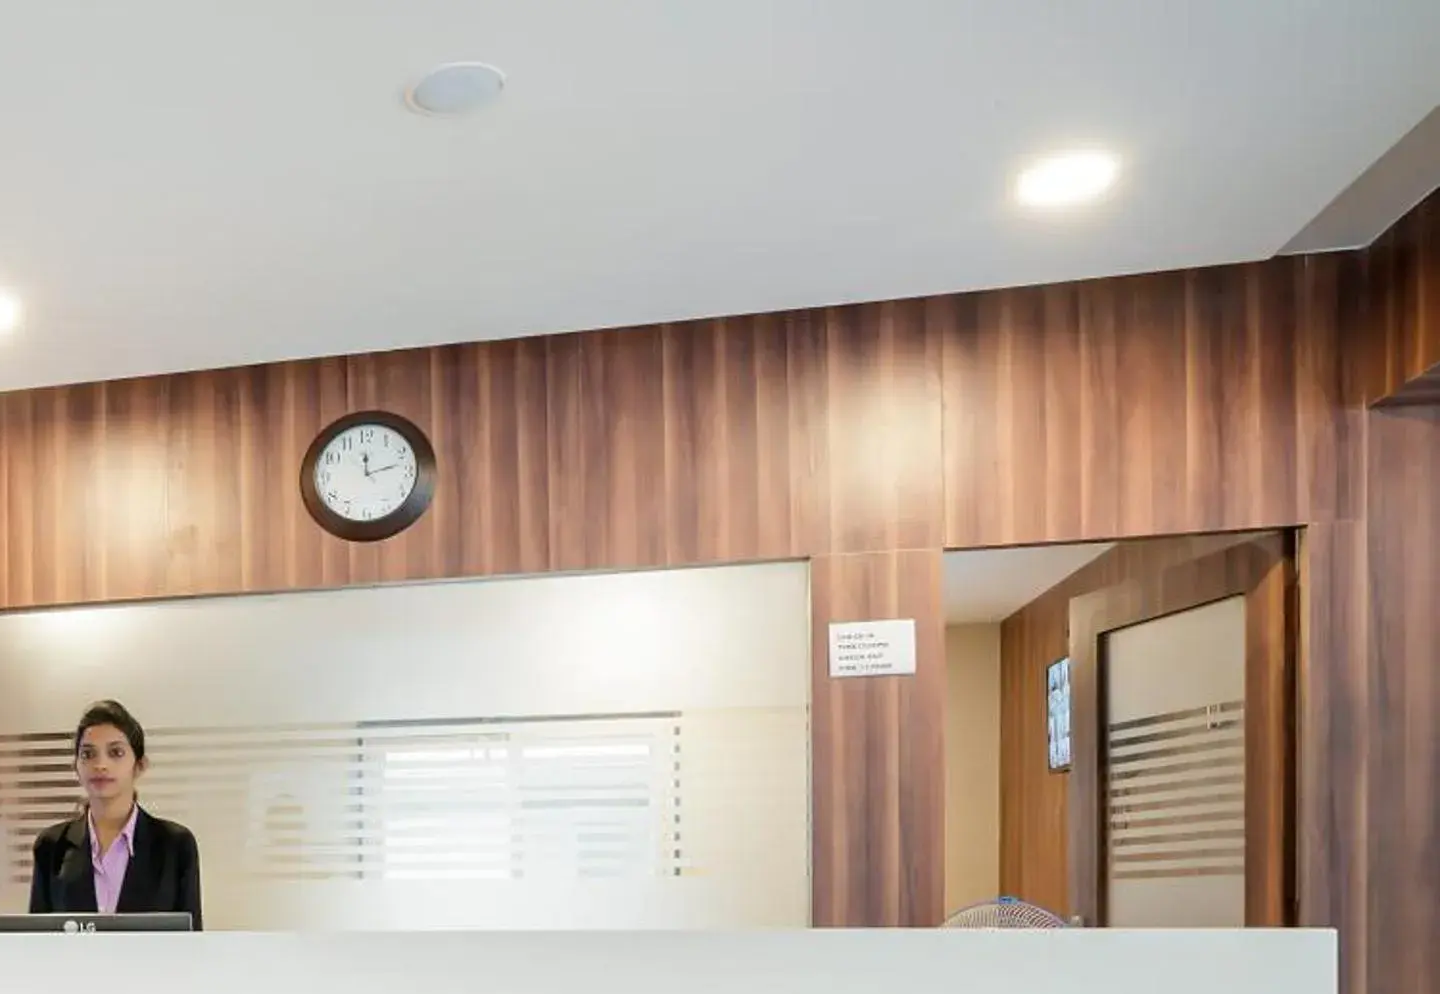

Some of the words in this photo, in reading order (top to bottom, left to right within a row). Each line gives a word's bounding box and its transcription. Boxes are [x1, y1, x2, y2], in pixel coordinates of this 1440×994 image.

[342, 433, 352, 451] 11
[360, 428, 374, 444] 12
[325, 450, 340, 465] 10
[80, 920, 97, 933] LG
